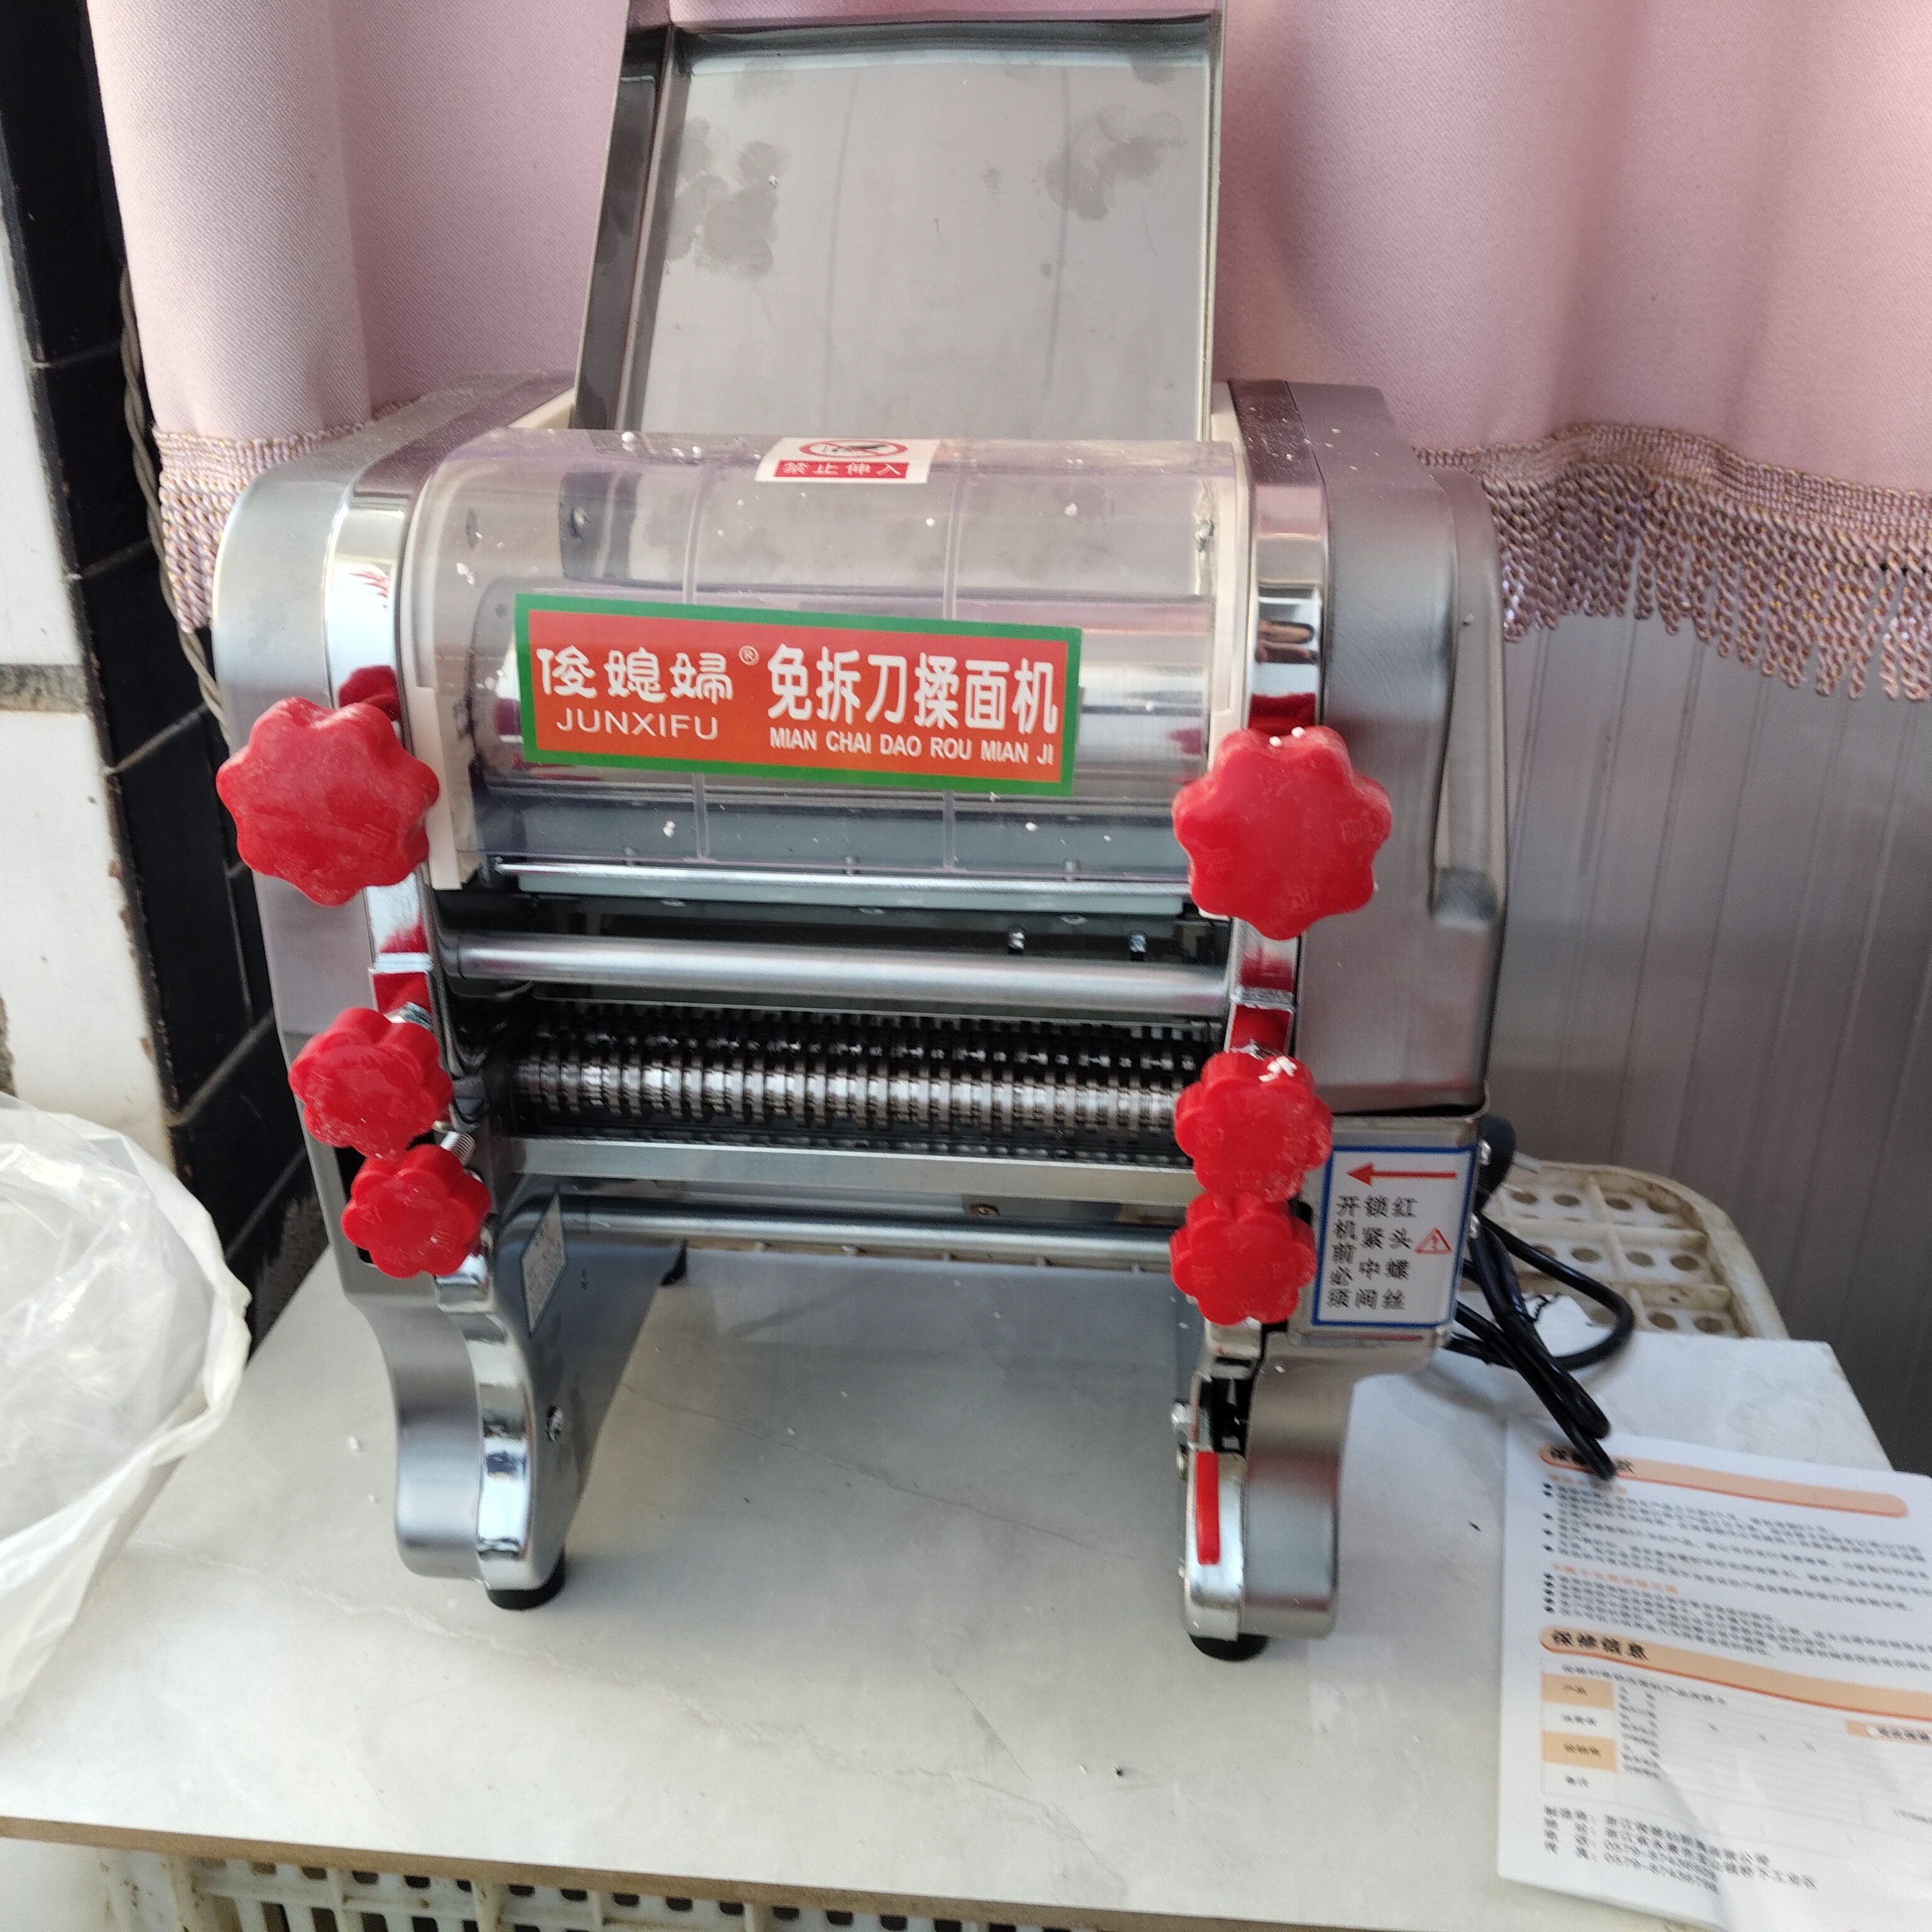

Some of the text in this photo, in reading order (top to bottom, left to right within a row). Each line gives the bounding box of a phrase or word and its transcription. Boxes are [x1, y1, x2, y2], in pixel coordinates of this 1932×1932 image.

[782, 462, 902, 476] 禁止伸入
[767, 643, 1059, 735] 免拆刀揉面机
[556, 707, 719, 740] JUNXIFU
[769, 726, 1054, 765] MIAN CHAI DAO ROU MIAN JI
